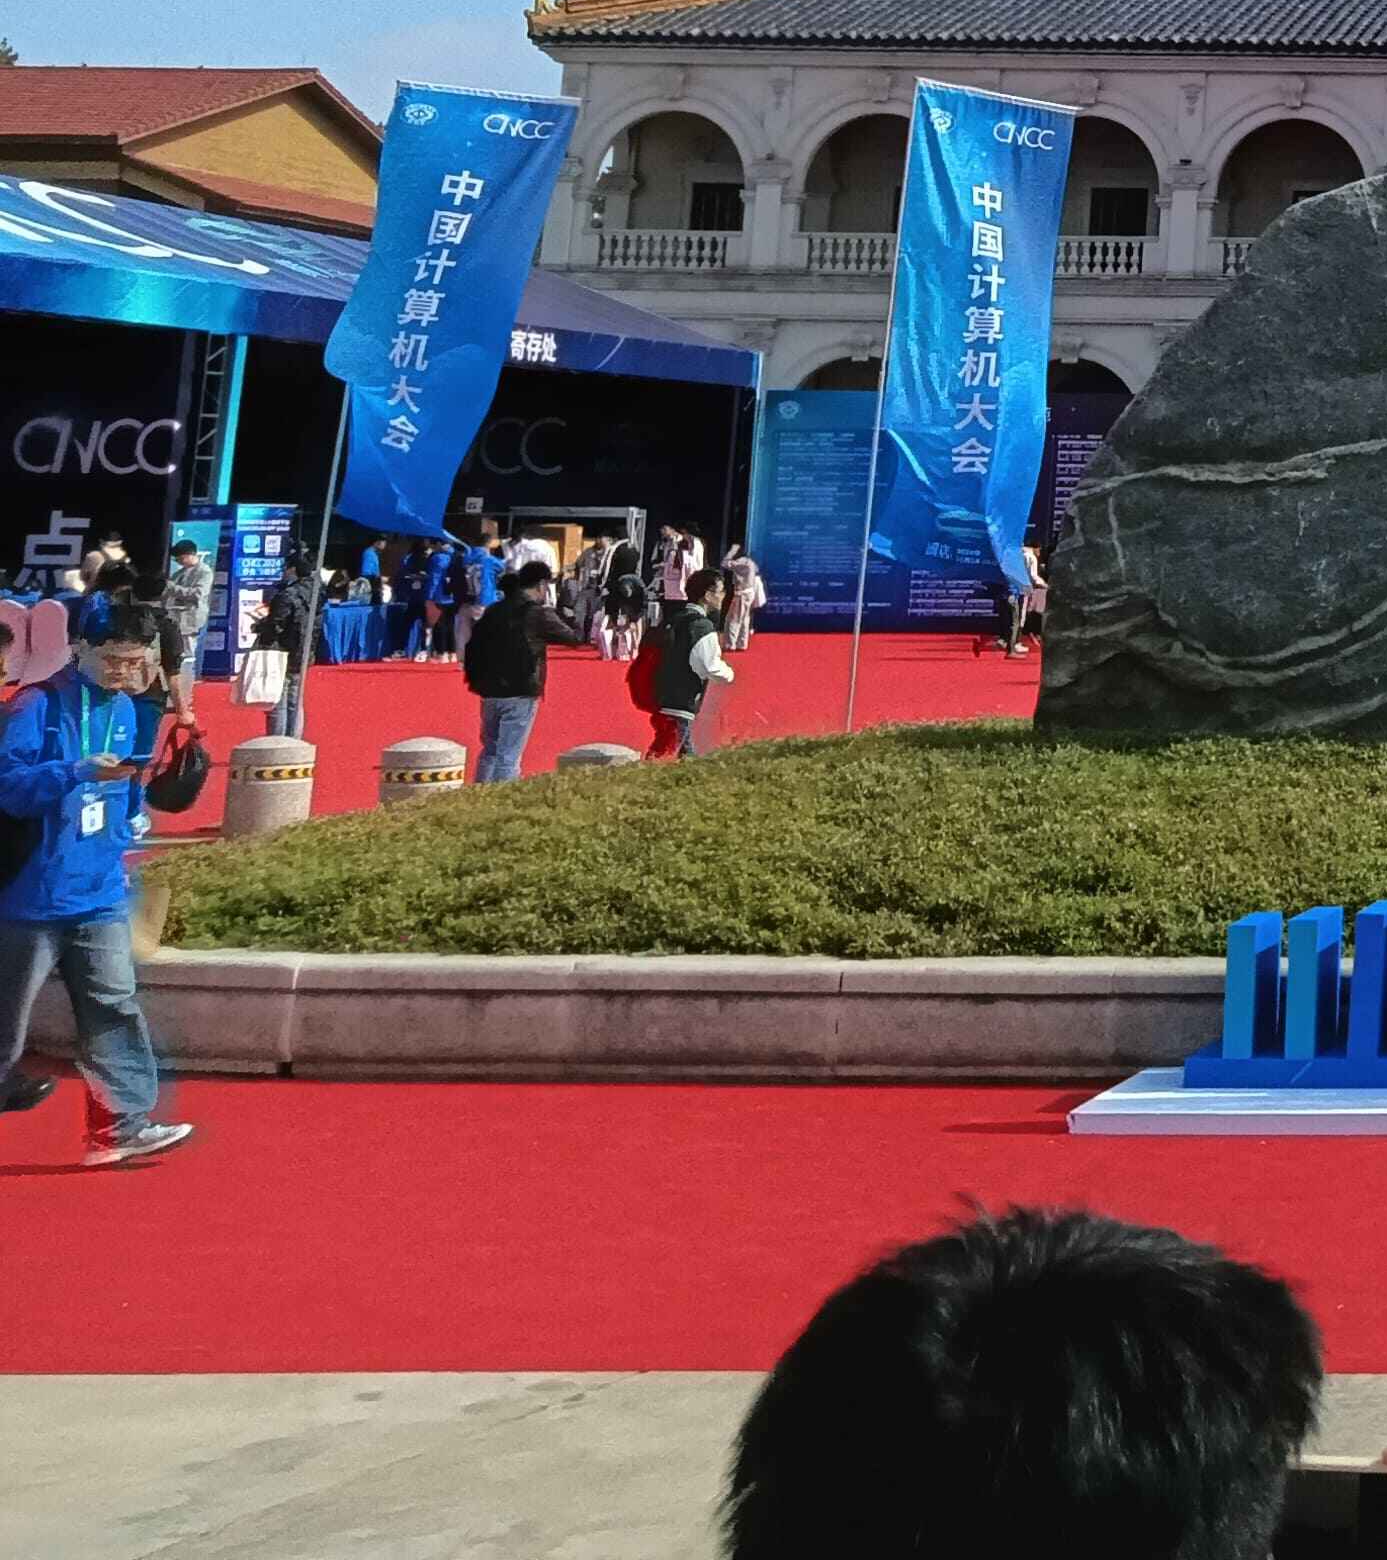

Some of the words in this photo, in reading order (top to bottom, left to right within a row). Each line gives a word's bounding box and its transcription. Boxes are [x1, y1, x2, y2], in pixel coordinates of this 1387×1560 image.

[483, 114, 555, 140] CNCC
[993, 122, 1056, 150] CNCC
[380, 167, 485, 454] 中国计算机大会
[950, 181, 1007, 476] 中国计算机大会
[510, 330, 557, 363] 寄存处
[14, 415, 181, 476] CNCC
